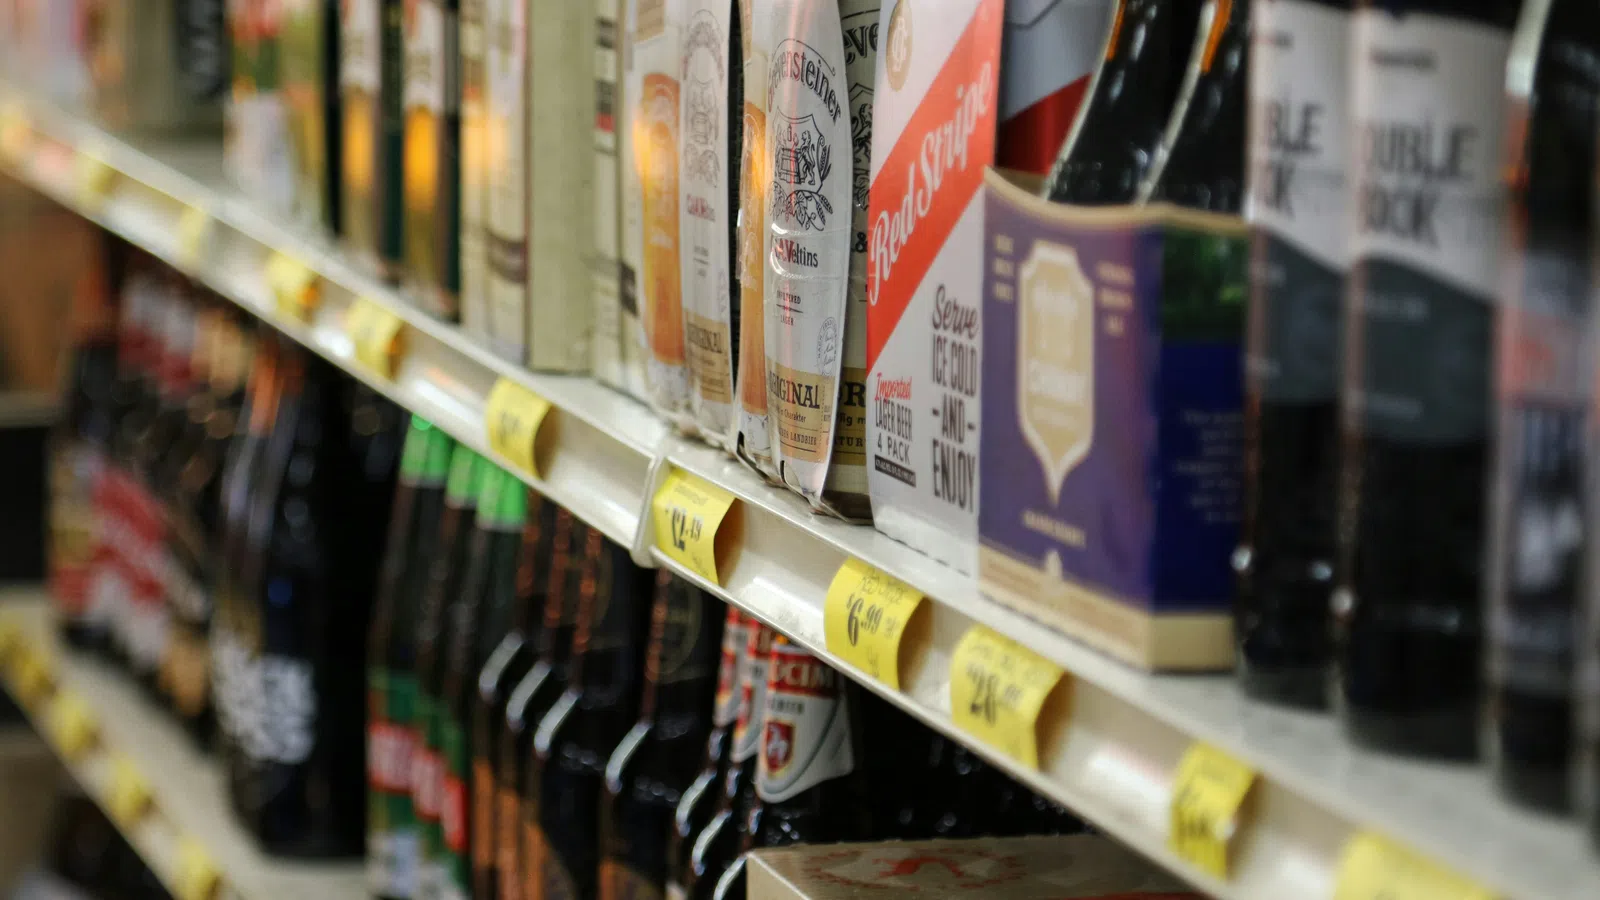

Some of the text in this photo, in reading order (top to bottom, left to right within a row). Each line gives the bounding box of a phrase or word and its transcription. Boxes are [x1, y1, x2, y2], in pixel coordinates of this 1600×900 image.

[869, 61, 993, 307] Red Stripe
[932, 284, 979, 340] Serve
[875, 372, 913, 403] Imported
[932, 333, 948, 388] ICE
[950, 340, 977, 398] COLD
[875, 396, 896, 436] LAGER
[896, 402, 913, 442] BEER
[877, 433, 911, 466] 4 PACK
[932, 438, 977, 513] ENJOY
